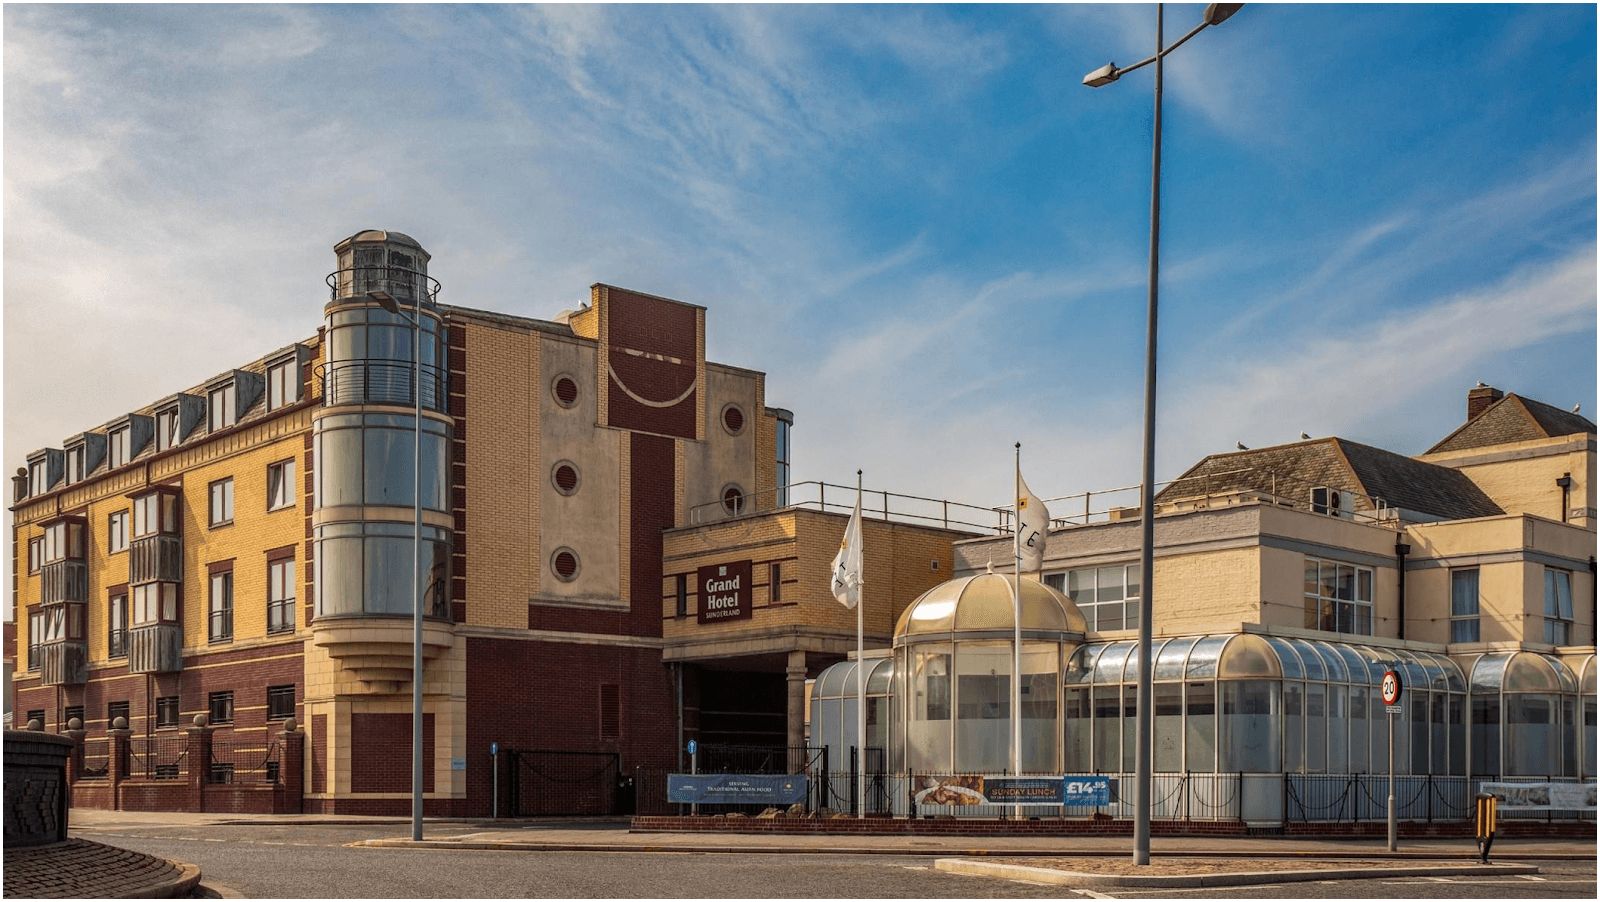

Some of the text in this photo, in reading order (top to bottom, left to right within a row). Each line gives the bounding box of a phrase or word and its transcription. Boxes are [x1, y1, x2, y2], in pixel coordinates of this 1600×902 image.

[706, 575, 740, 593] Grand
[707, 592, 738, 609] Hotel
[706, 609, 740, 618] SUNDERLAND
[1384, 681, 1394, 694] 20
[1067, 781, 1106, 794] £14.95
